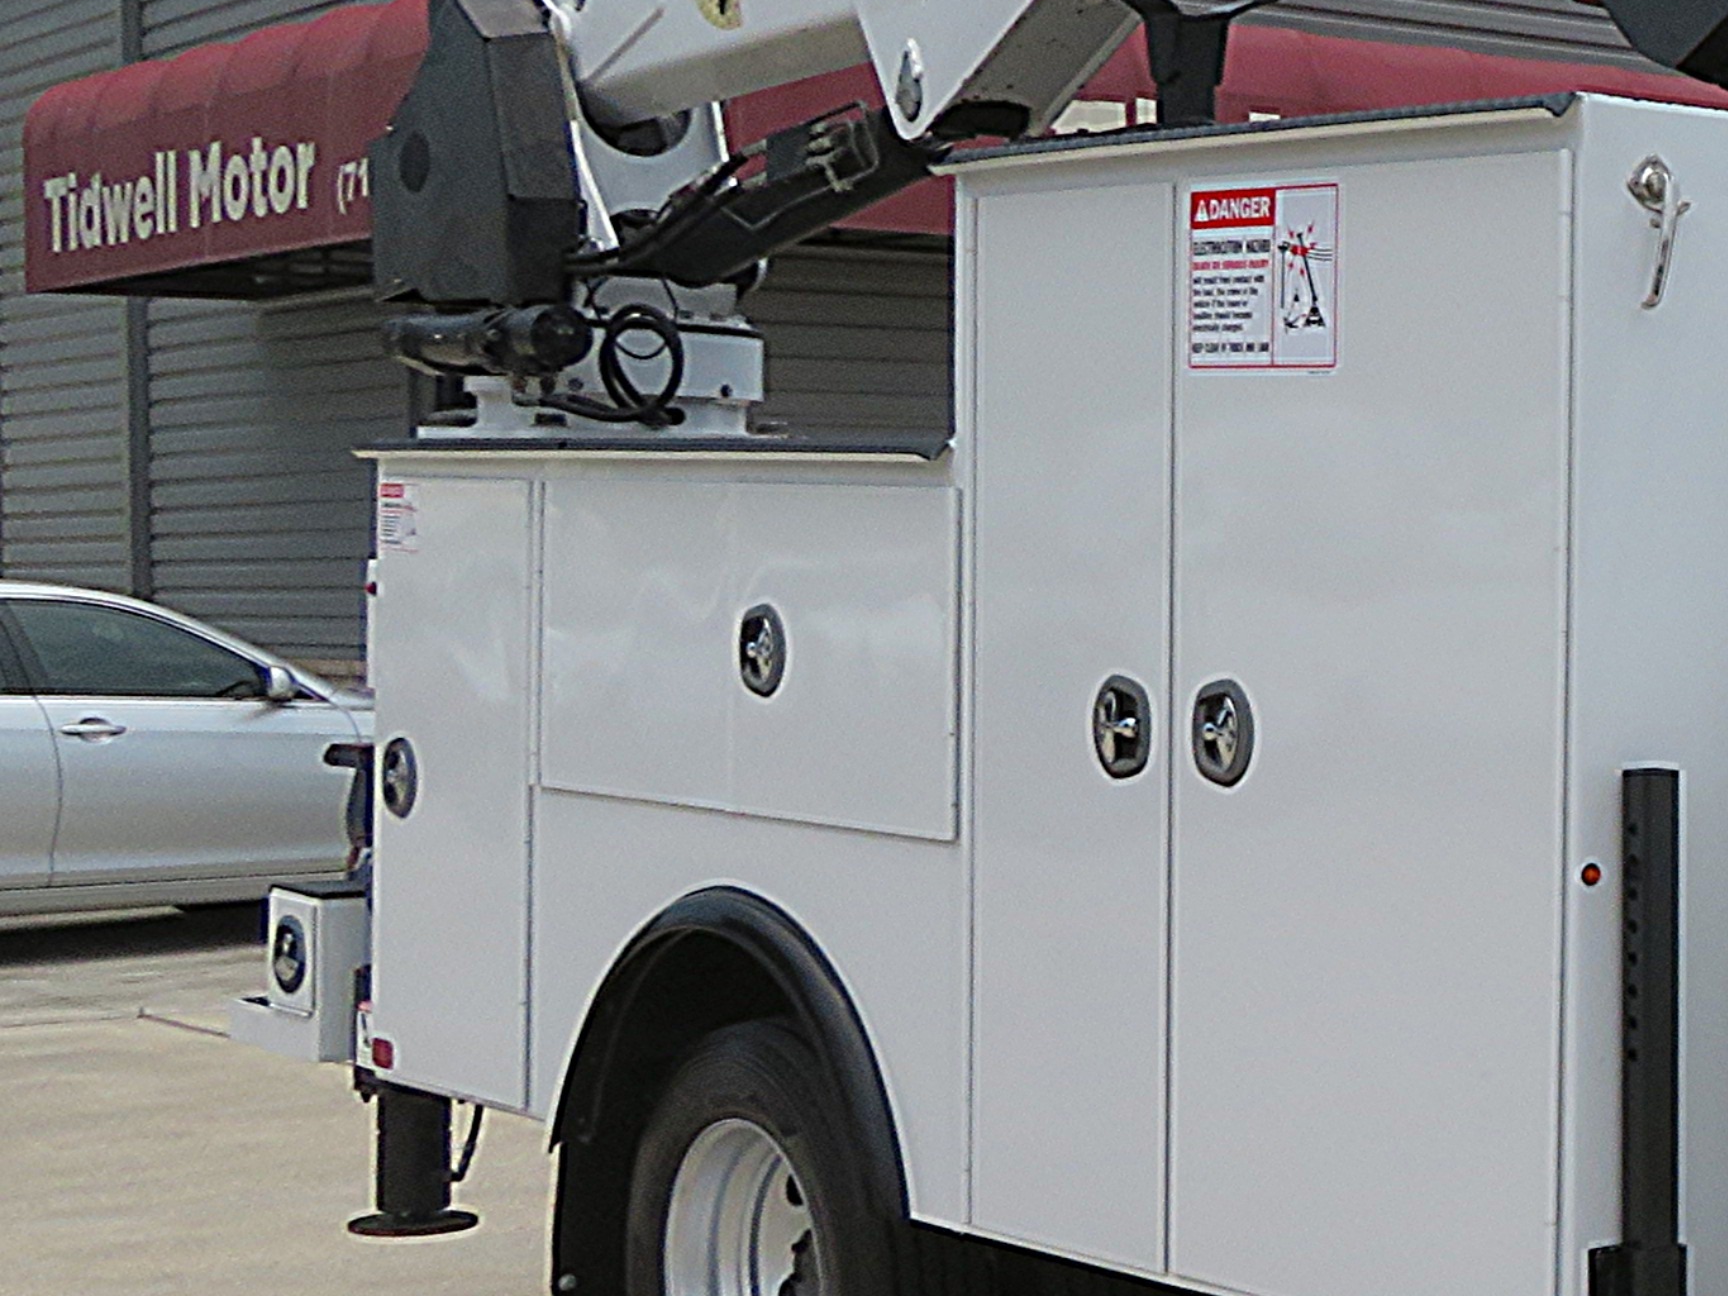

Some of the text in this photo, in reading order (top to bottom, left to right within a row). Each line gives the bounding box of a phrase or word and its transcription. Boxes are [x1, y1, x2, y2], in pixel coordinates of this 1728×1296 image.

[44, 149, 178, 253] Tidwell
[189, 136, 316, 229] Motor
[1209, 196, 1271, 221] DANGER
